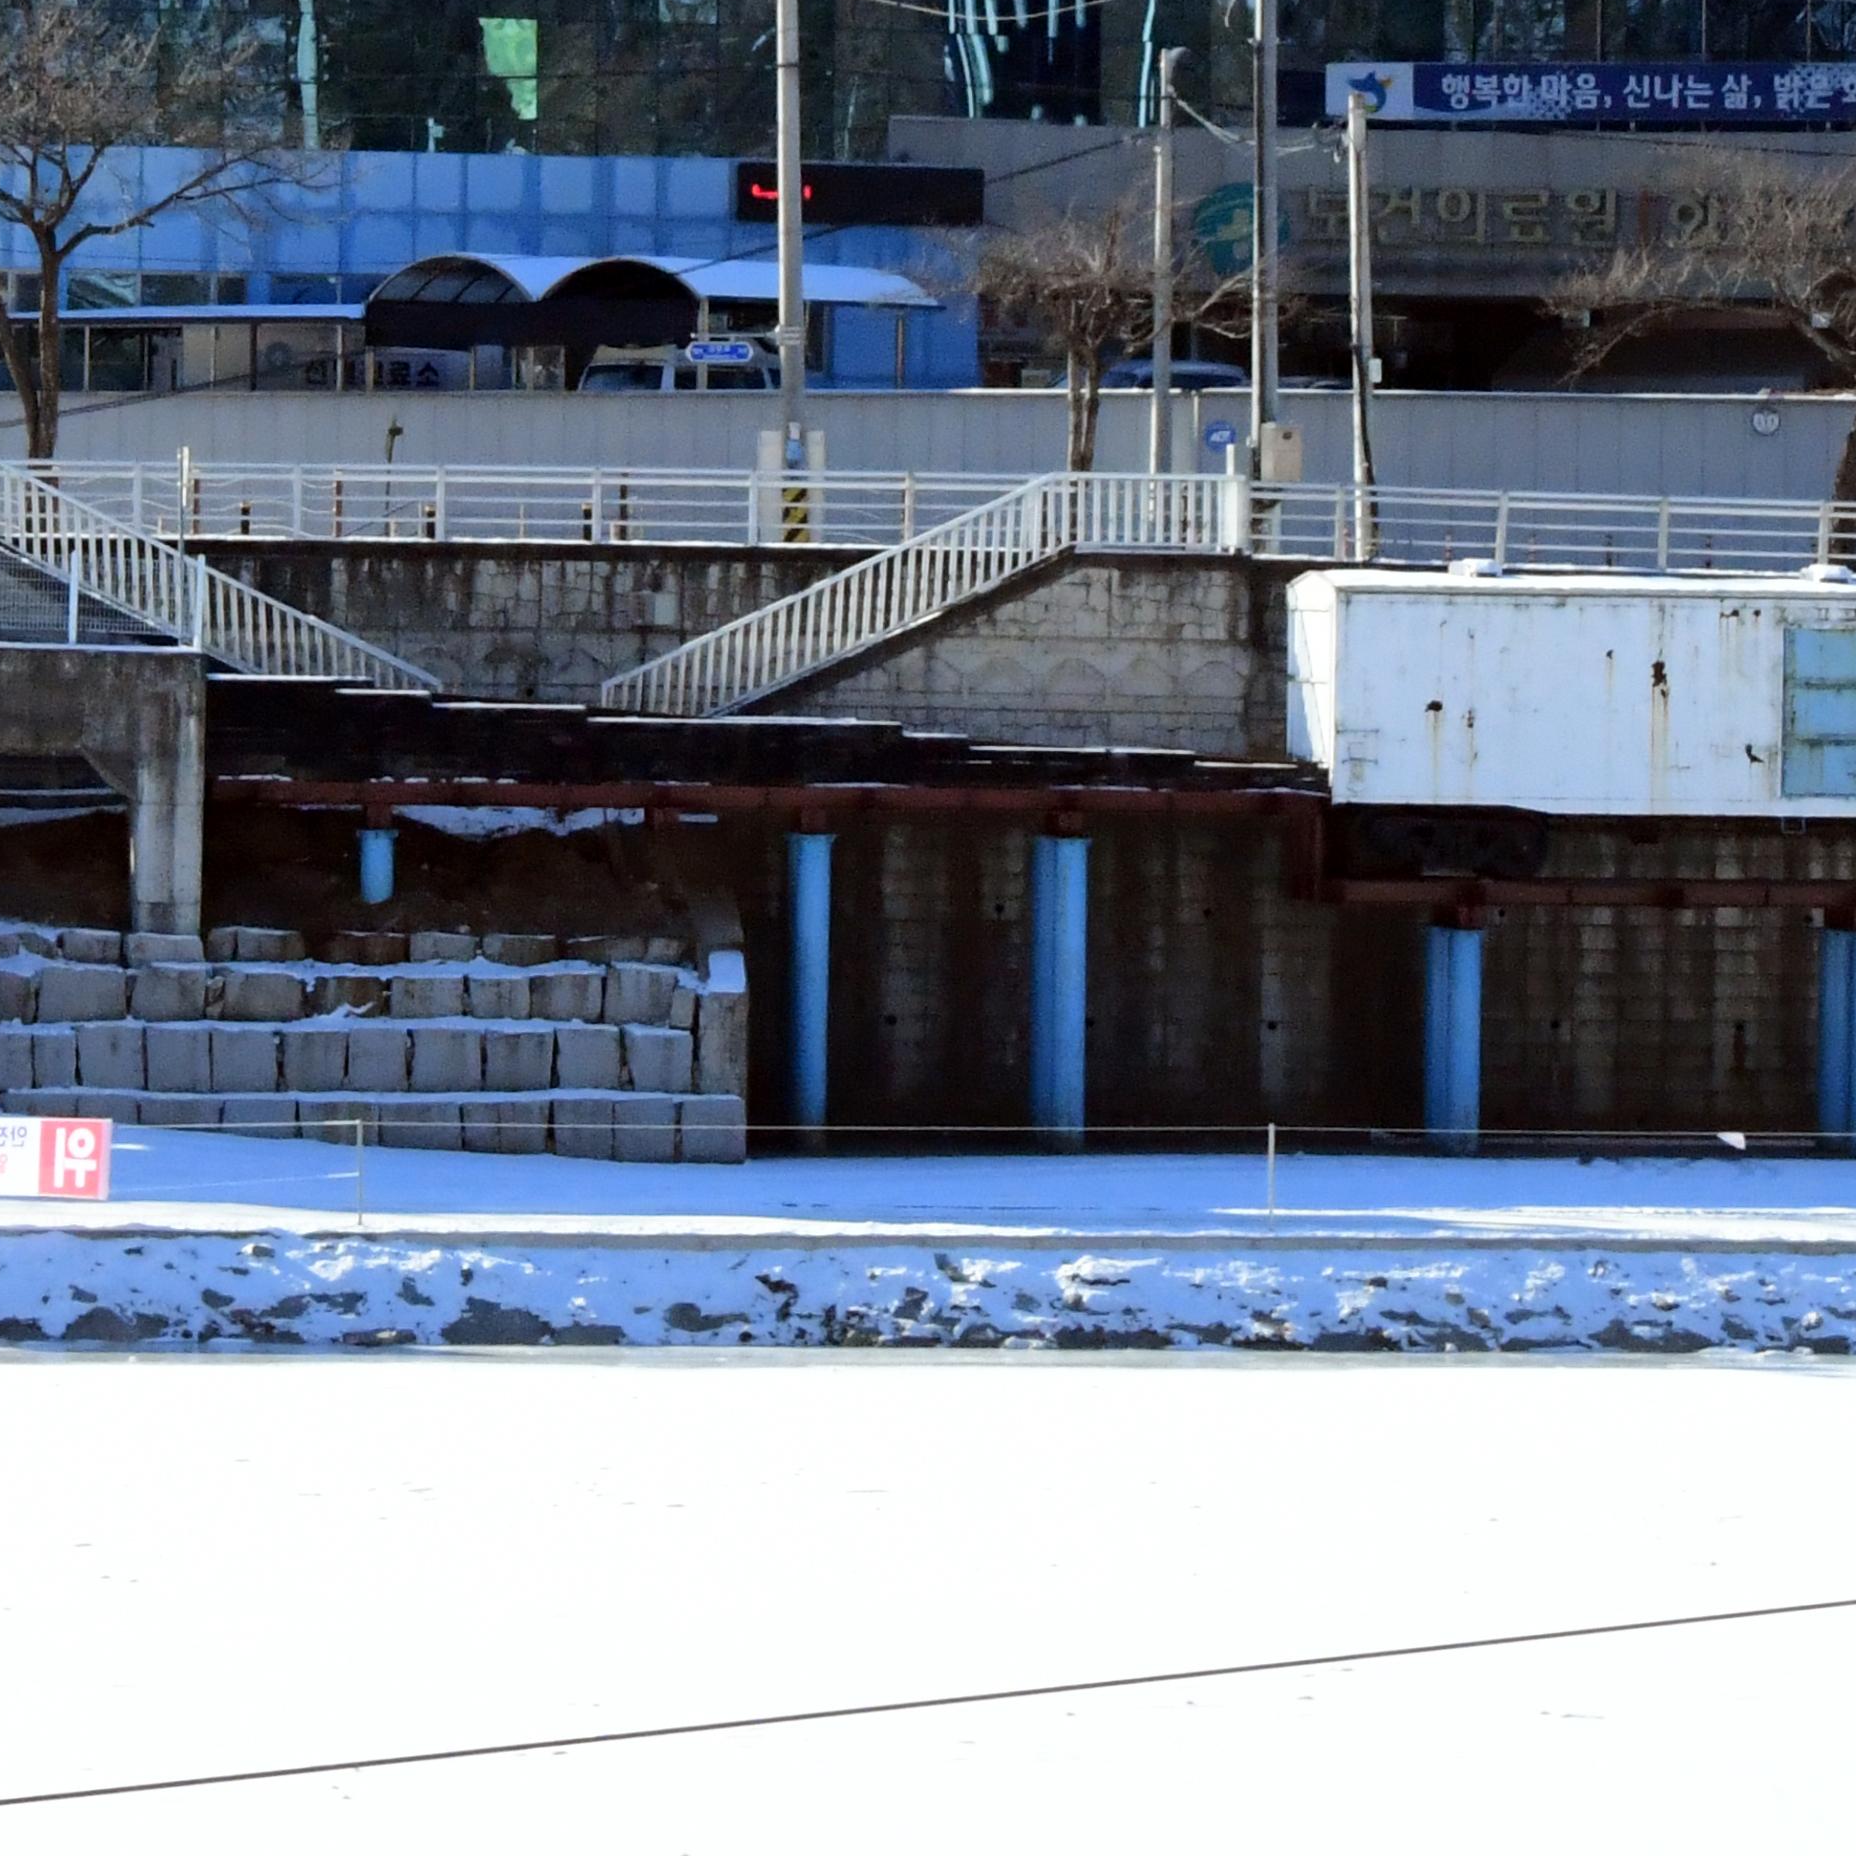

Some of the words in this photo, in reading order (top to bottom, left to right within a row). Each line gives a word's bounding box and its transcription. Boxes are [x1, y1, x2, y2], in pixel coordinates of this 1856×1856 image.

[1442, 73, 1530, 109] 행복한
[1541, 74, 1612, 109] 마음,
[1623, 74, 1713, 109] 신나는
[1721, 74, 1762, 109] 삶,
[1774, 74, 1834, 111] 밝은
[1307, 186, 1620, 243] 보건의료원
